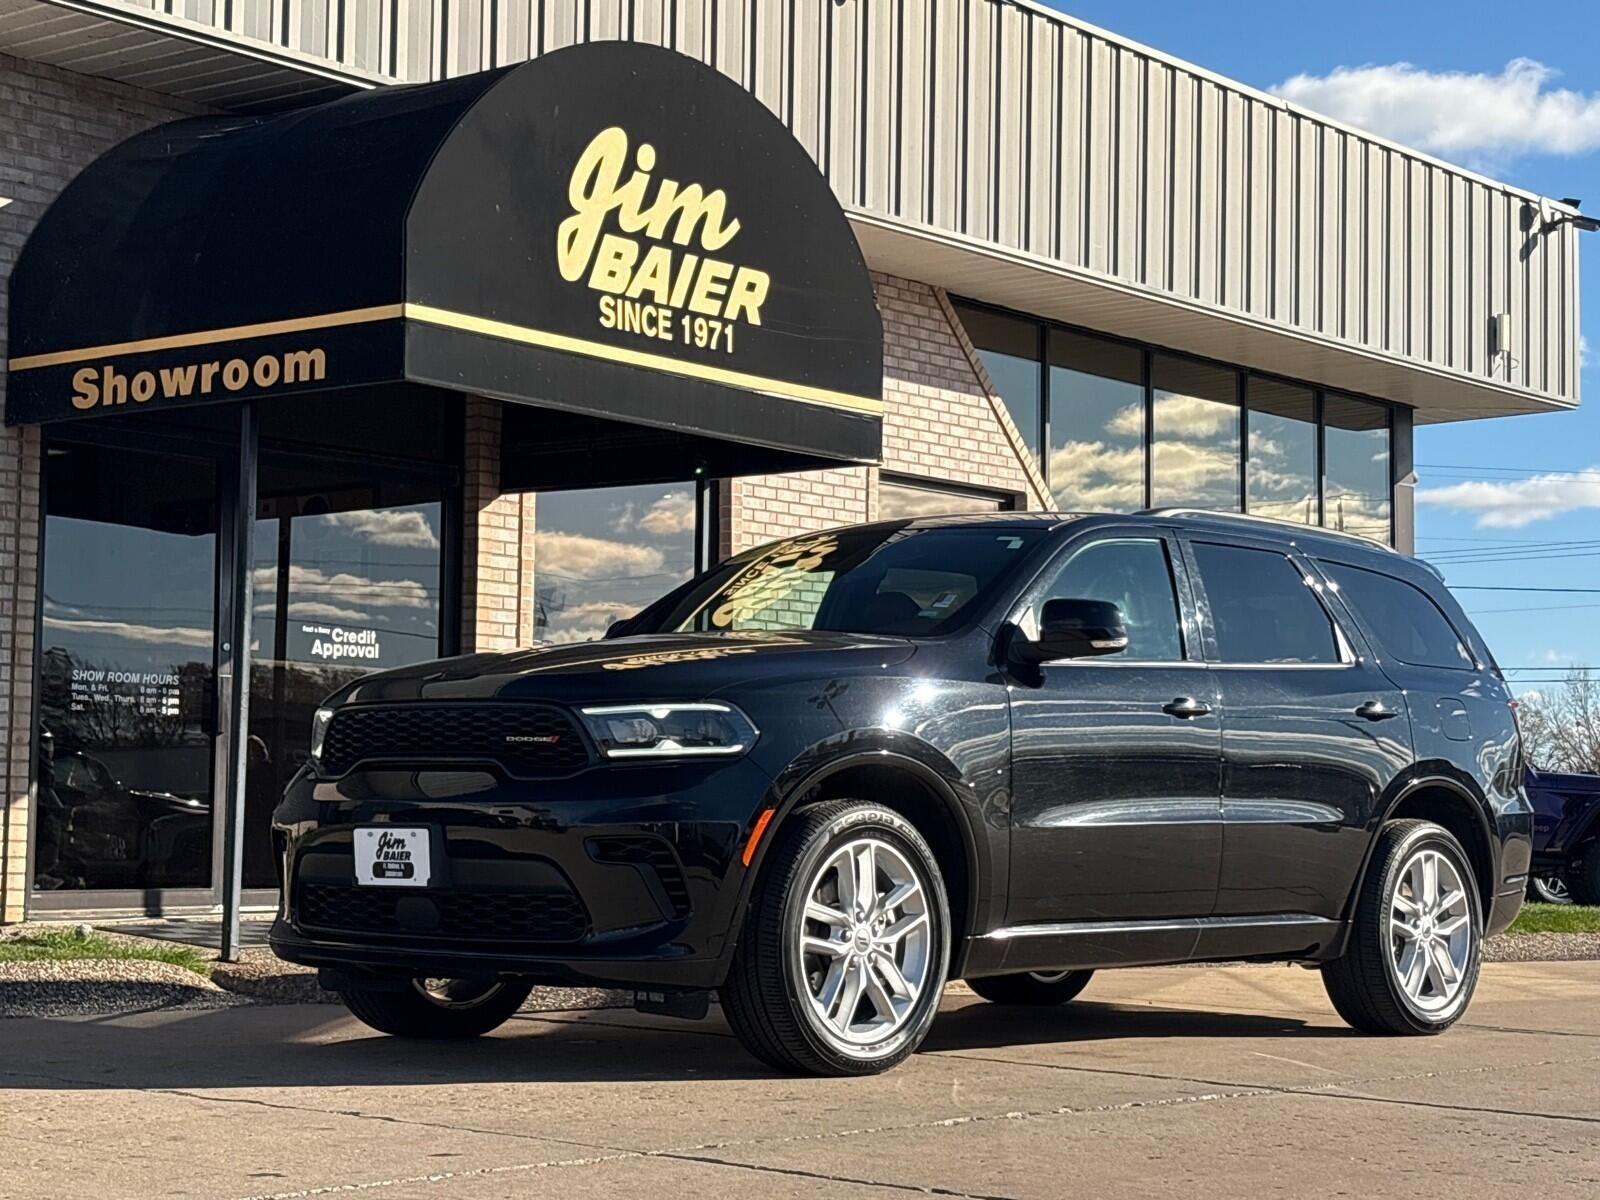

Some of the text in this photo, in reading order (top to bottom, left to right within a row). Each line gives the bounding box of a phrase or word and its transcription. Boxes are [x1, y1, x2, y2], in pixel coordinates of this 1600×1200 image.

[557, 127, 741, 282] Jim
[588, 233, 770, 326] BAIER
[600, 295, 733, 353] SINCE 1971
[72, 349, 326, 409] Showroom
[332, 628, 376, 644] Credit
[311, 639, 379, 659] Approval
[72, 669, 180, 685] SHOW ROOM HOURS
[161, 706, 167, 714] 5
[167, 707, 180, 716] pm
[167, 697, 180, 706] pm
[376, 831, 406, 860] Jim
[383, 850, 411, 861] BAIER
